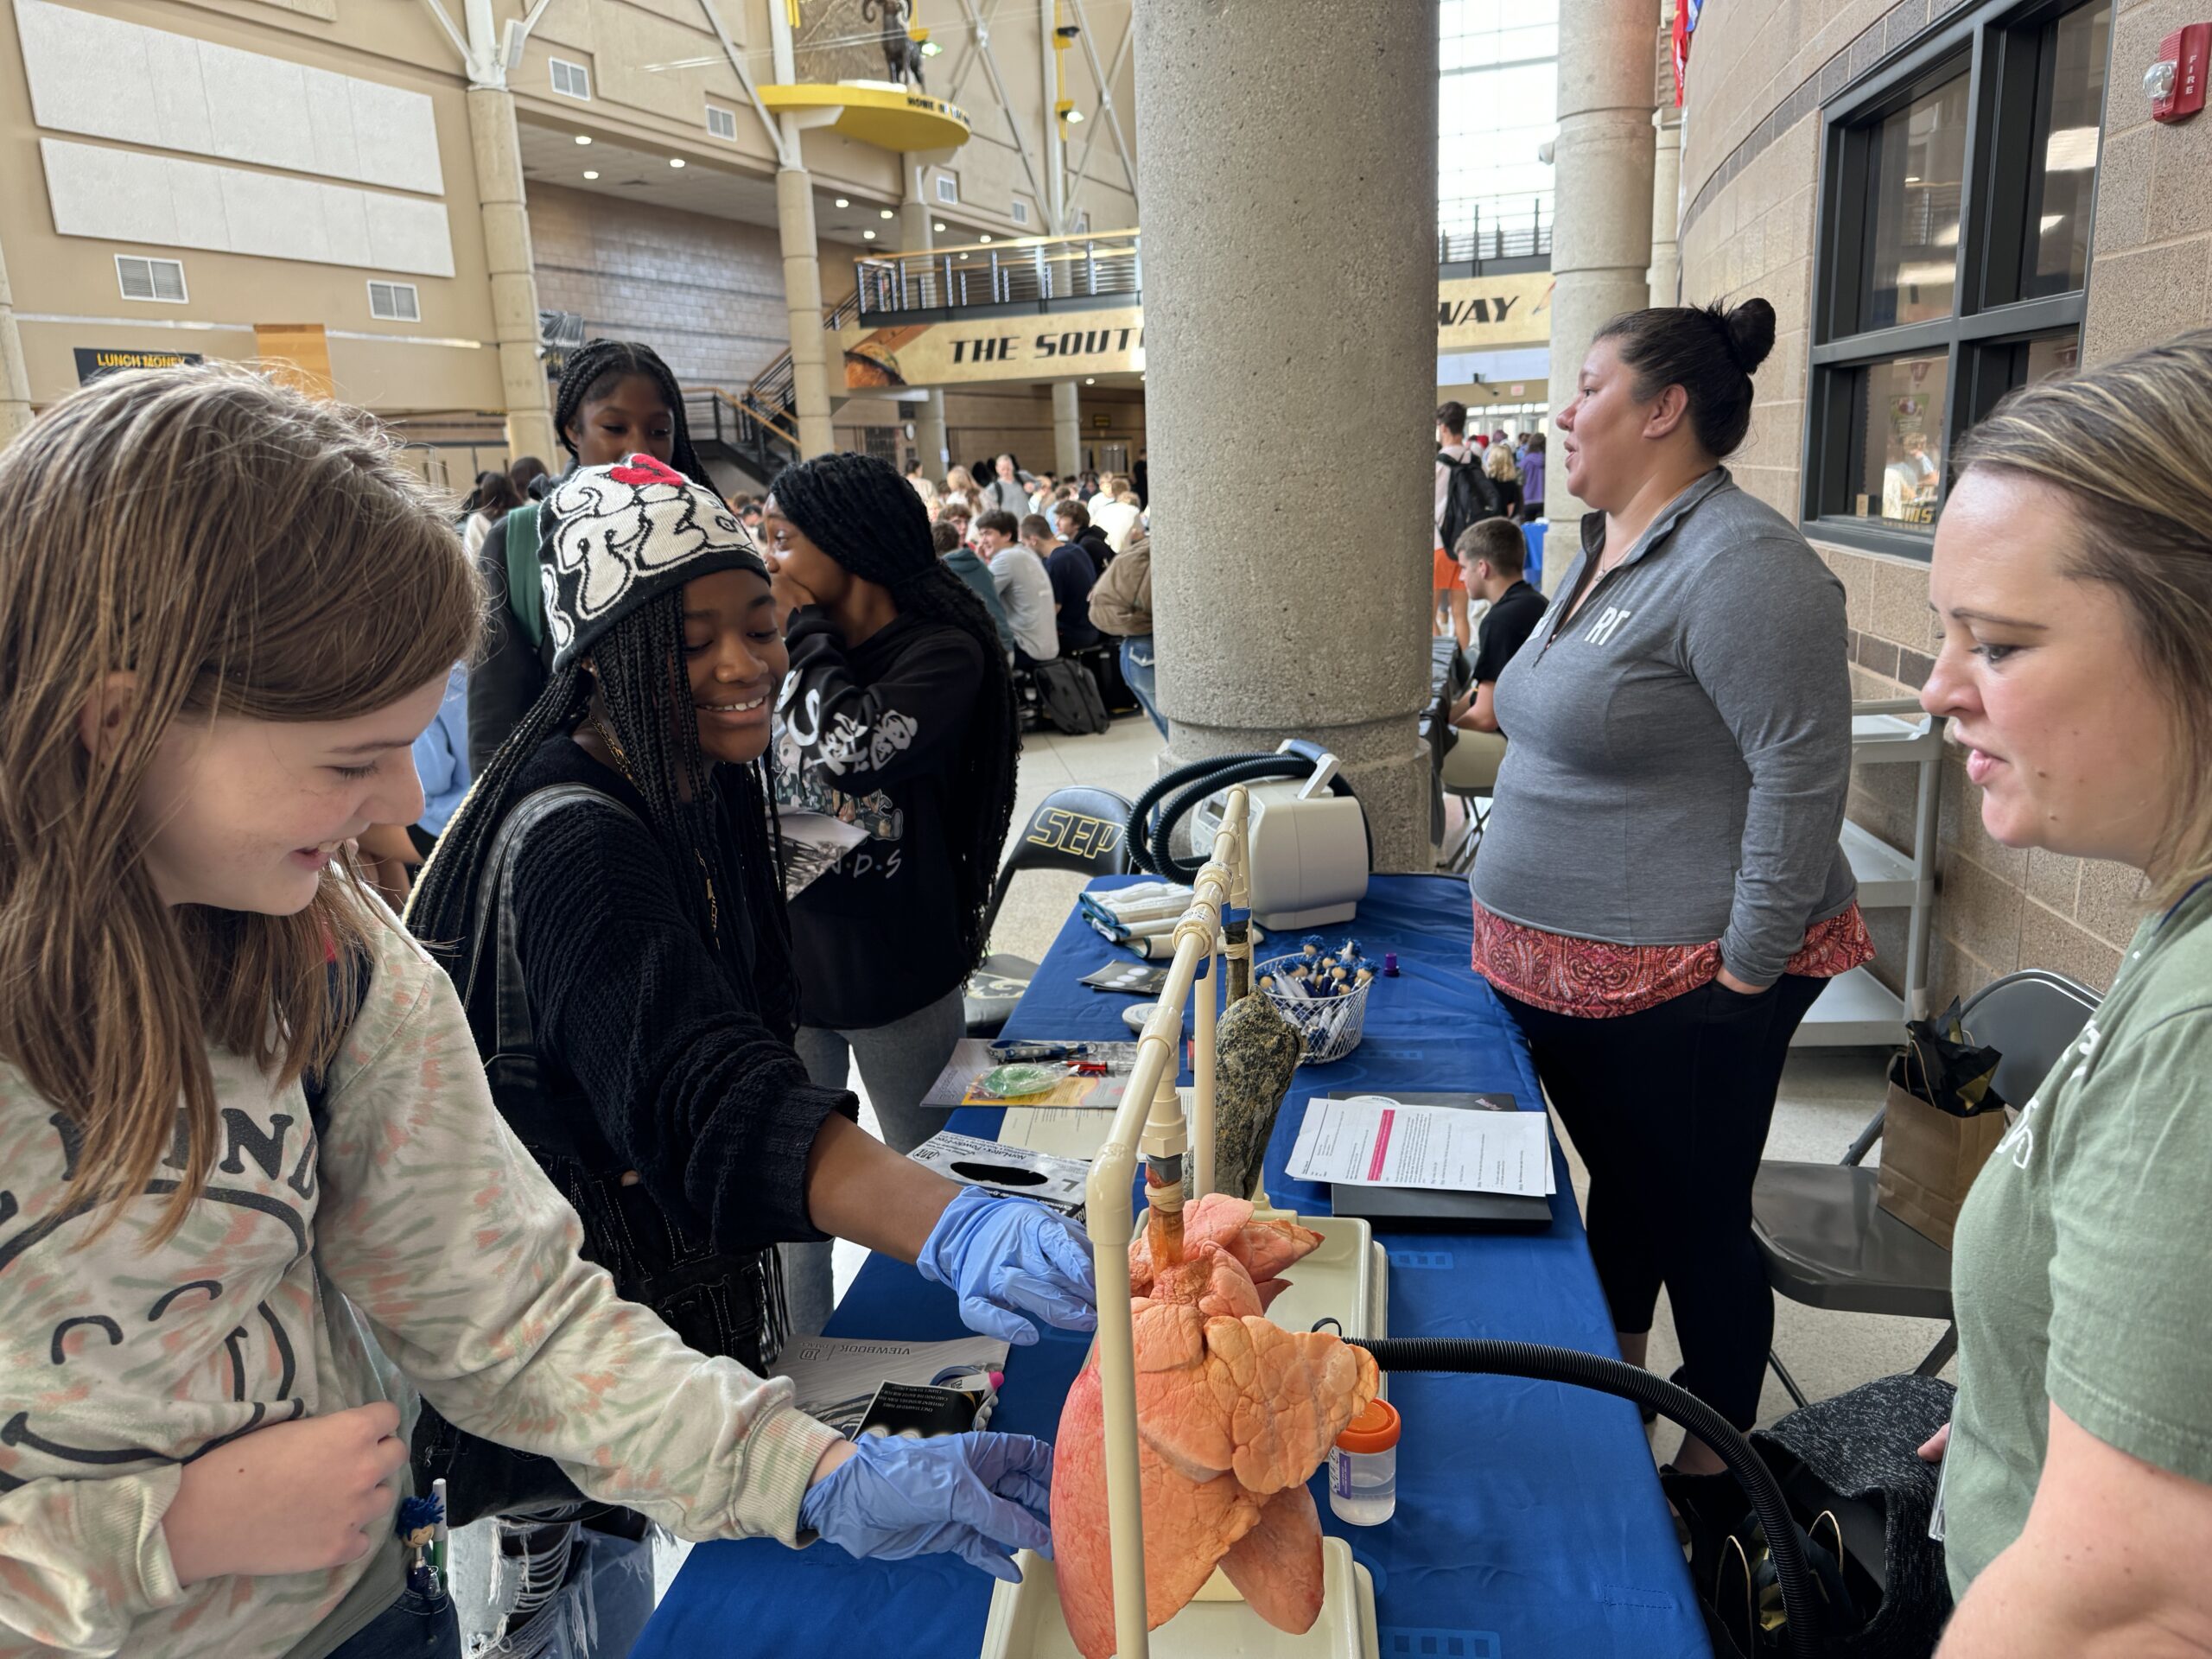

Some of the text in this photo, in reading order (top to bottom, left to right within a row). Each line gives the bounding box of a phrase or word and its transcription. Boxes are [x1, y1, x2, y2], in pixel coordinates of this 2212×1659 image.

[2184, 54, 2197, 95] FIRE
[96, 353, 185, 368] LUNCH MONEY
[949, 327, 1145, 364] THE SOUT
[1584, 606, 1631, 646] RT
[1027, 806, 1125, 859] SEP
[1061, 1178, 1081, 1193] L
[840, 1344, 911, 1356] VIEWBOOK
